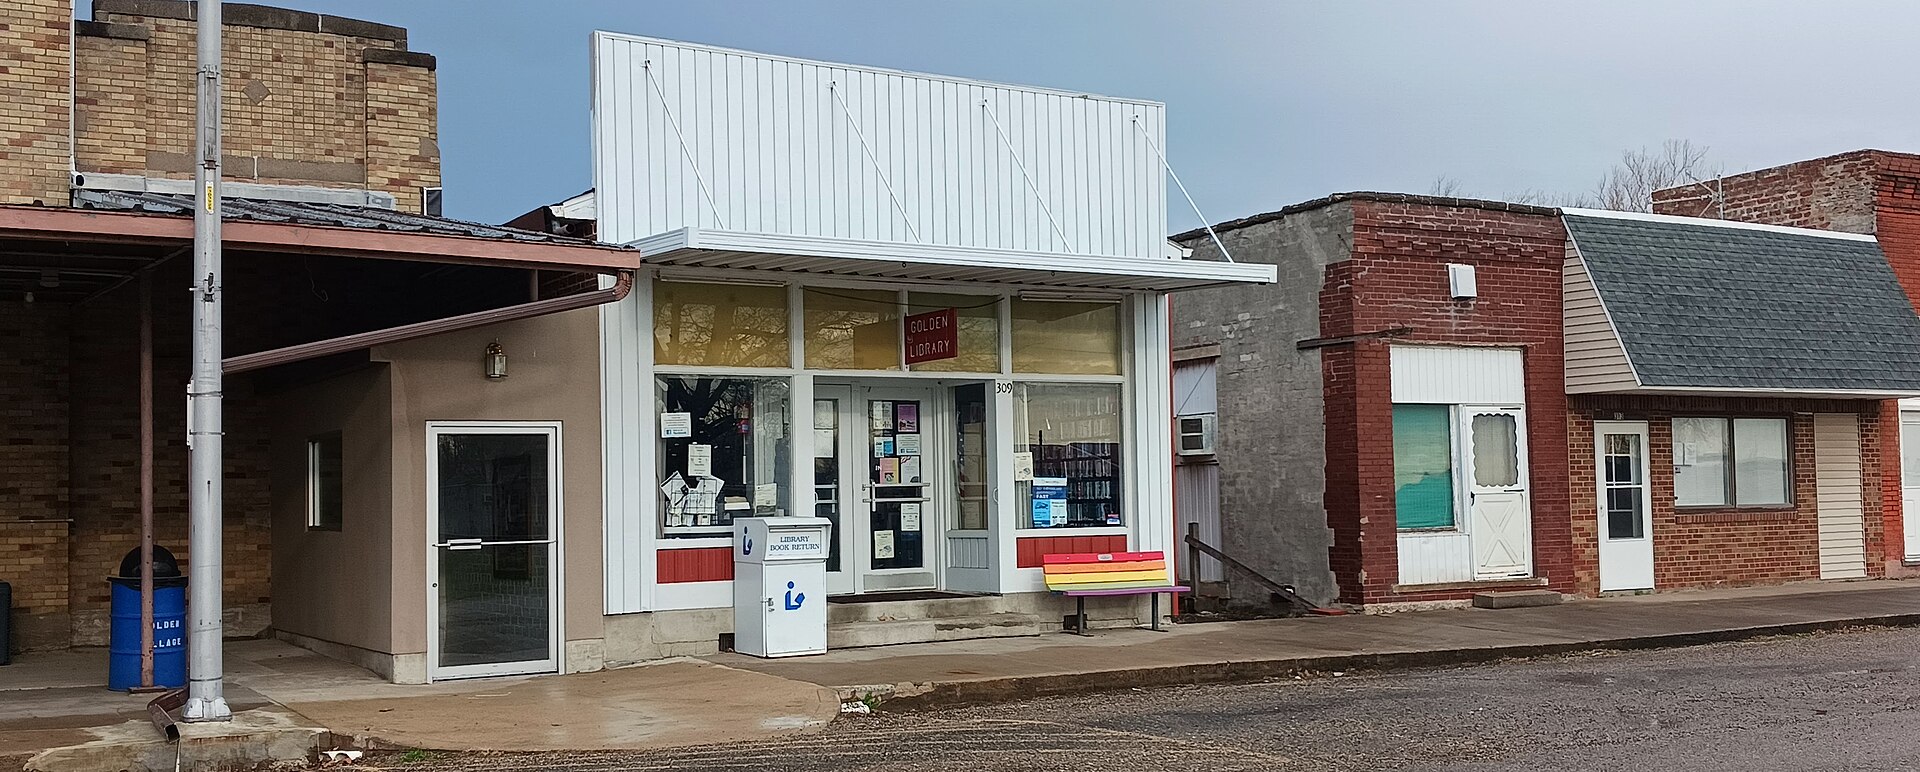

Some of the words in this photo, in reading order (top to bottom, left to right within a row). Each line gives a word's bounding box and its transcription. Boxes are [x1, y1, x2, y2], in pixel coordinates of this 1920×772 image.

[910, 314, 948, 333] GOLDEN
[910, 340, 950, 357] LIBRARY
[996, 383, 1013, 394] 309
[153, 620, 180, 630] LDEN
[152, 637, 181, 648] LAGE
